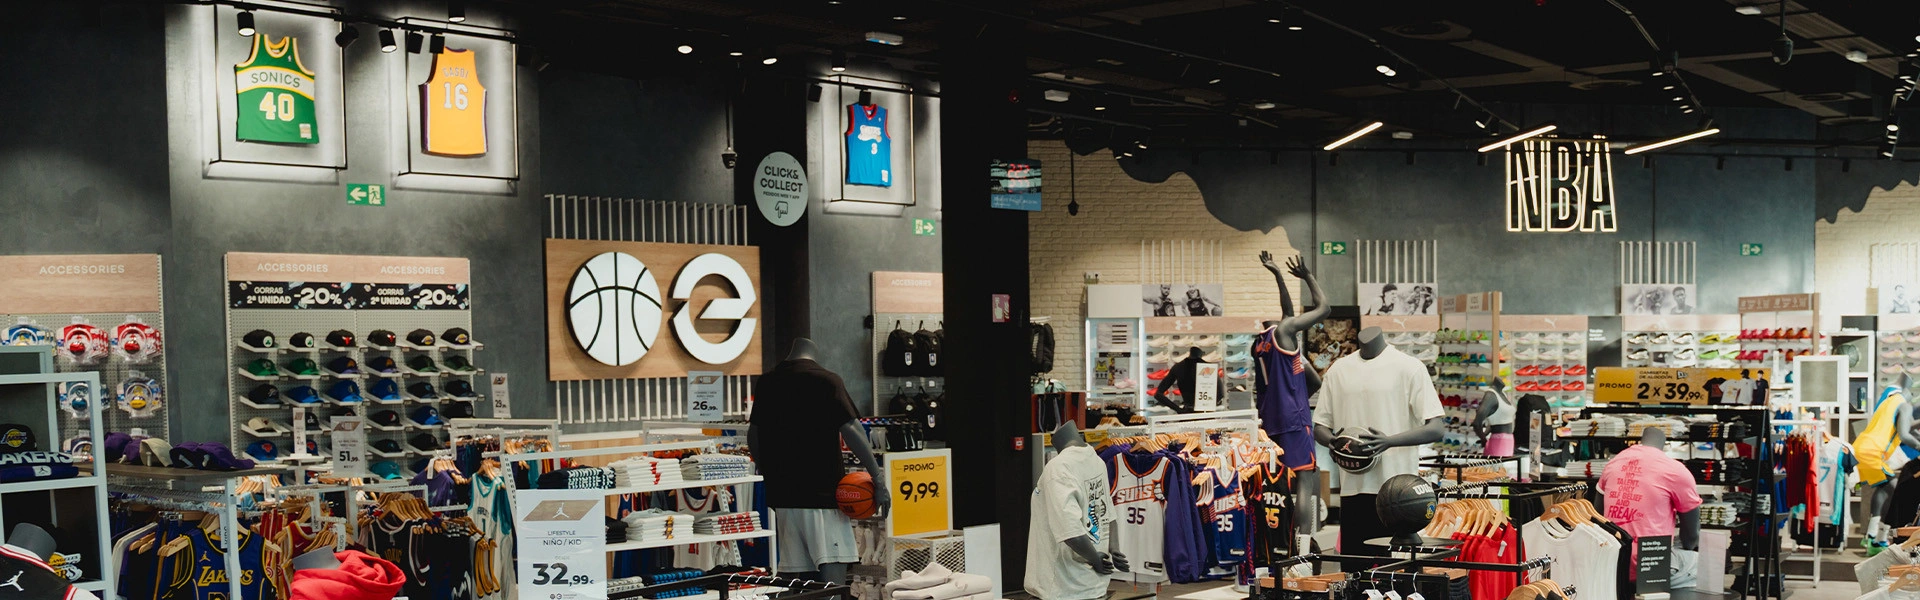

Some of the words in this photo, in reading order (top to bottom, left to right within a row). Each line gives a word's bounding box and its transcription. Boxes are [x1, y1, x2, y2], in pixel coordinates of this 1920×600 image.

[251, 72, 301, 88] SONICS
[443, 81, 469, 111] 16
[259, 91, 295, 122] 40
[764, 165, 799, 180] CLICK&
[760, 177, 803, 193] COLLECT
[1506, 139, 1617, 232] NBA
[39, 264, 125, 275] ACCESSORIES
[257, 263, 329, 273] ACCESSORIES
[380, 265, 446, 275] ACCESSORIES
[254, 286, 284, 294] GORRAS
[293, 287, 343, 305] -20%
[377, 288, 404, 296] GORRAS
[413, 289, 458, 306] -20%
[258, 295, 292, 305] UNIDAD
[380, 297, 412, 305] UNIDAD
[1637, 382, 1650, 400] 2
[903, 462, 935, 472] PROMO
[1127, 506, 1146, 525] 35
[1607, 505, 1638, 521] FREAK
[1216, 513, 1234, 532] 35
[543, 538, 563, 546] NIÑO
[197, 565, 254, 587] LAKS
